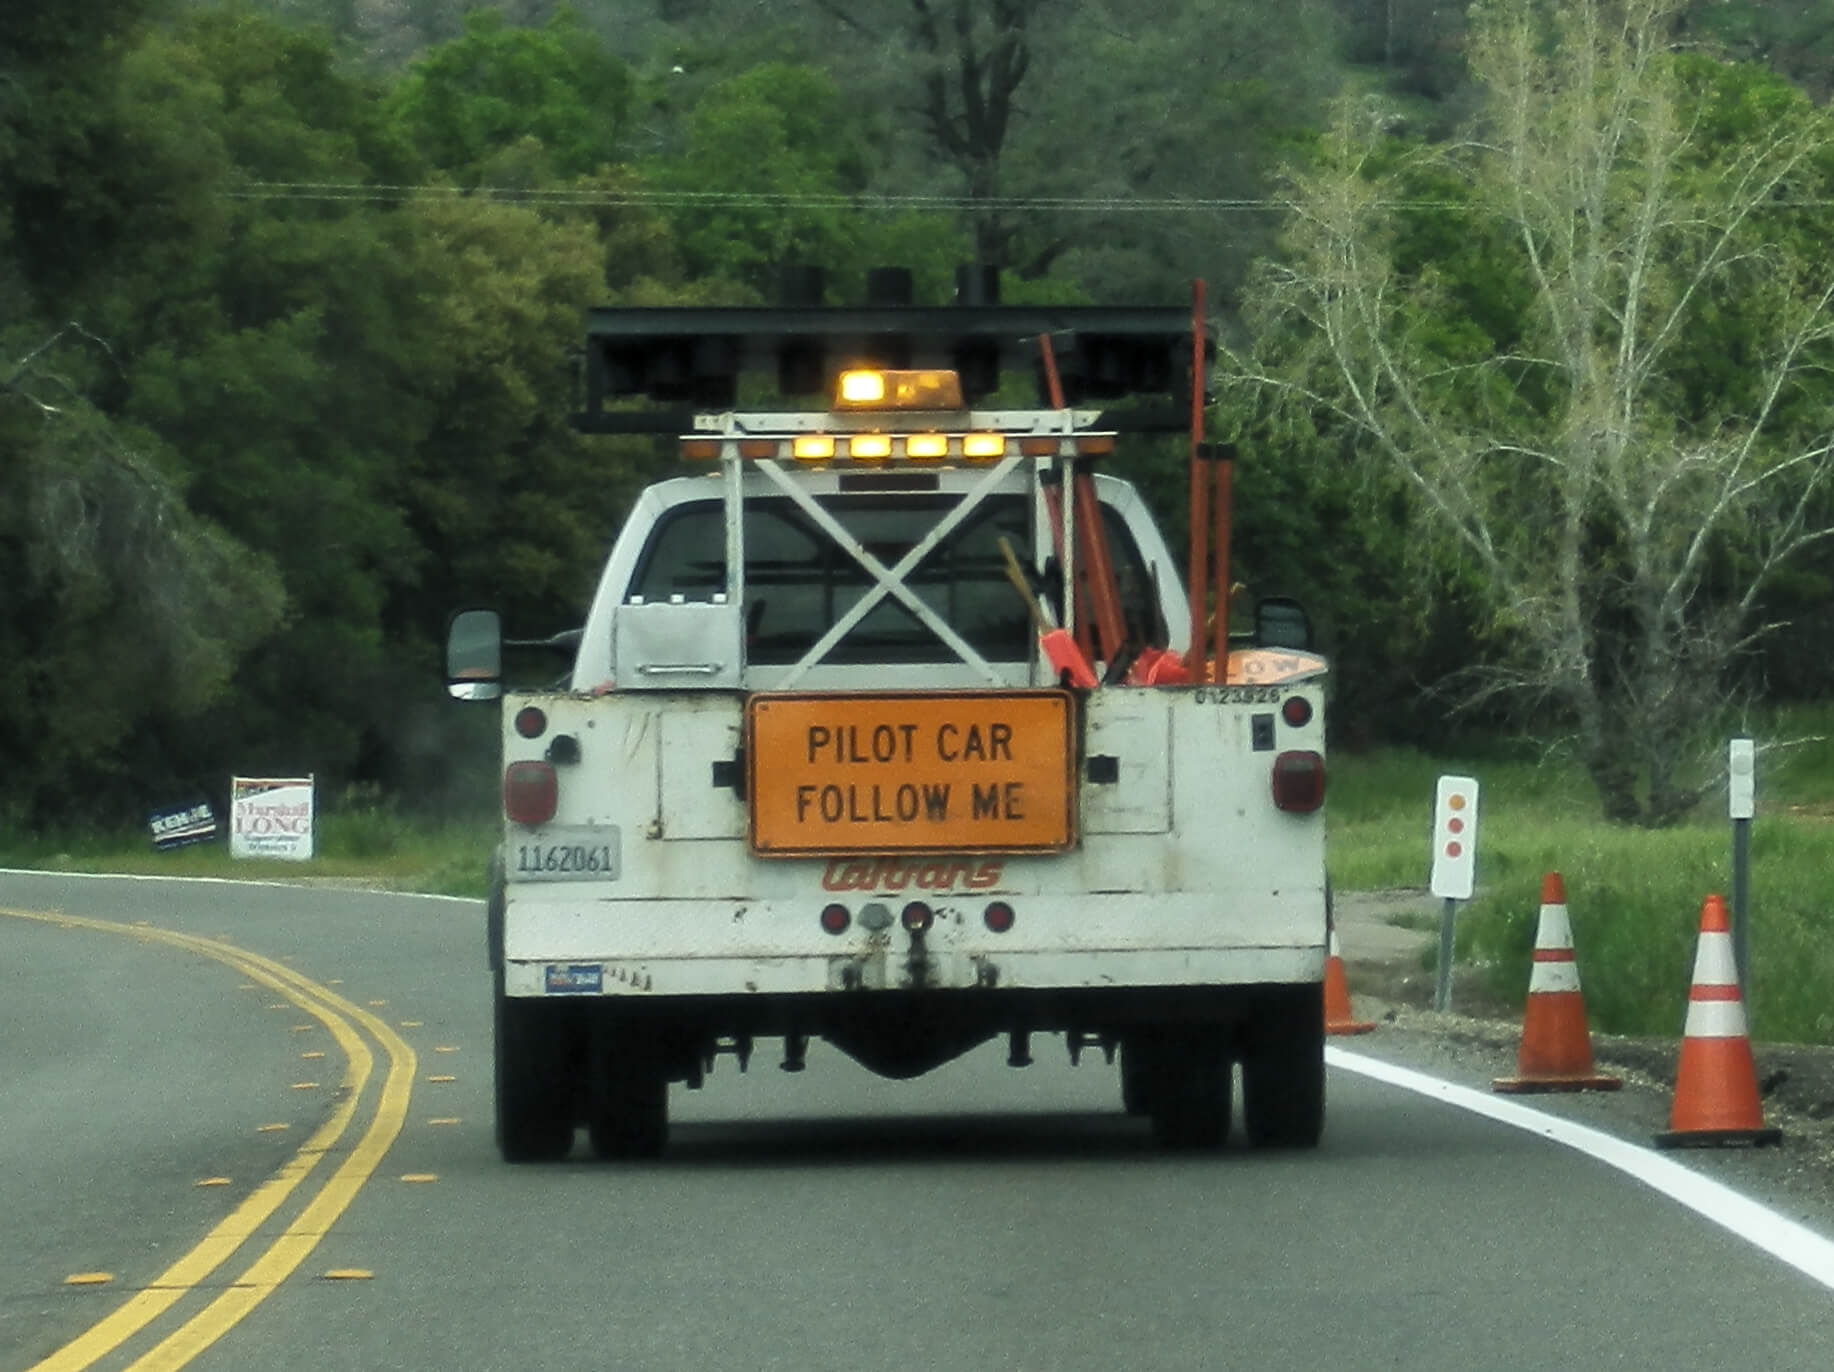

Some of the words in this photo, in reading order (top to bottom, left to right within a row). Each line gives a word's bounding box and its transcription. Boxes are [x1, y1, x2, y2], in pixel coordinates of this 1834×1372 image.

[807, 725, 918, 763] PILOT
[937, 723, 1014, 762] CAR
[796, 783, 951, 823] FOLLOW
[971, 782, 1026, 820] ME
[236, 816, 310, 833] LONG
[518, 846, 613, 872] 1162061
